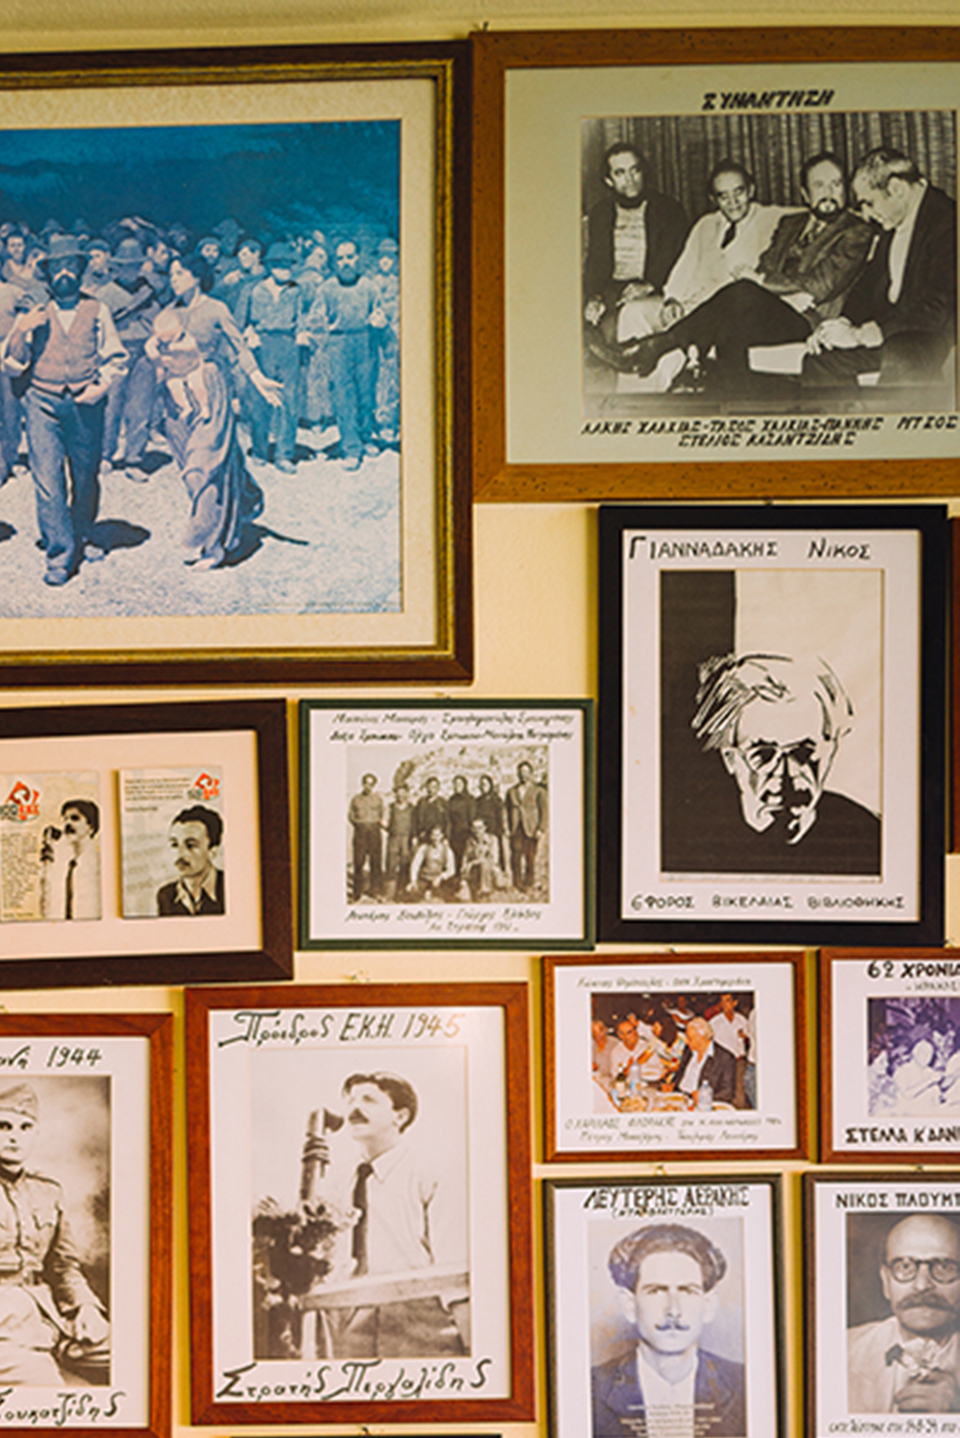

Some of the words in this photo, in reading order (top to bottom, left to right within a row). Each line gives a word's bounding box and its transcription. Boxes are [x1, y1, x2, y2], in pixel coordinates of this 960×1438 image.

[701, 89, 836, 111] ΣΥΝΑΝΤΗΣΗ
[629, 536, 779, 560] ΓΙΑΝΝΑΔΑΚΗΣ
[403, 1011, 466, 1038] 1945
[46, 1045, 103, 1069] 1944
[836, 1193, 889, 1209] ΝΙΚΟΣ
